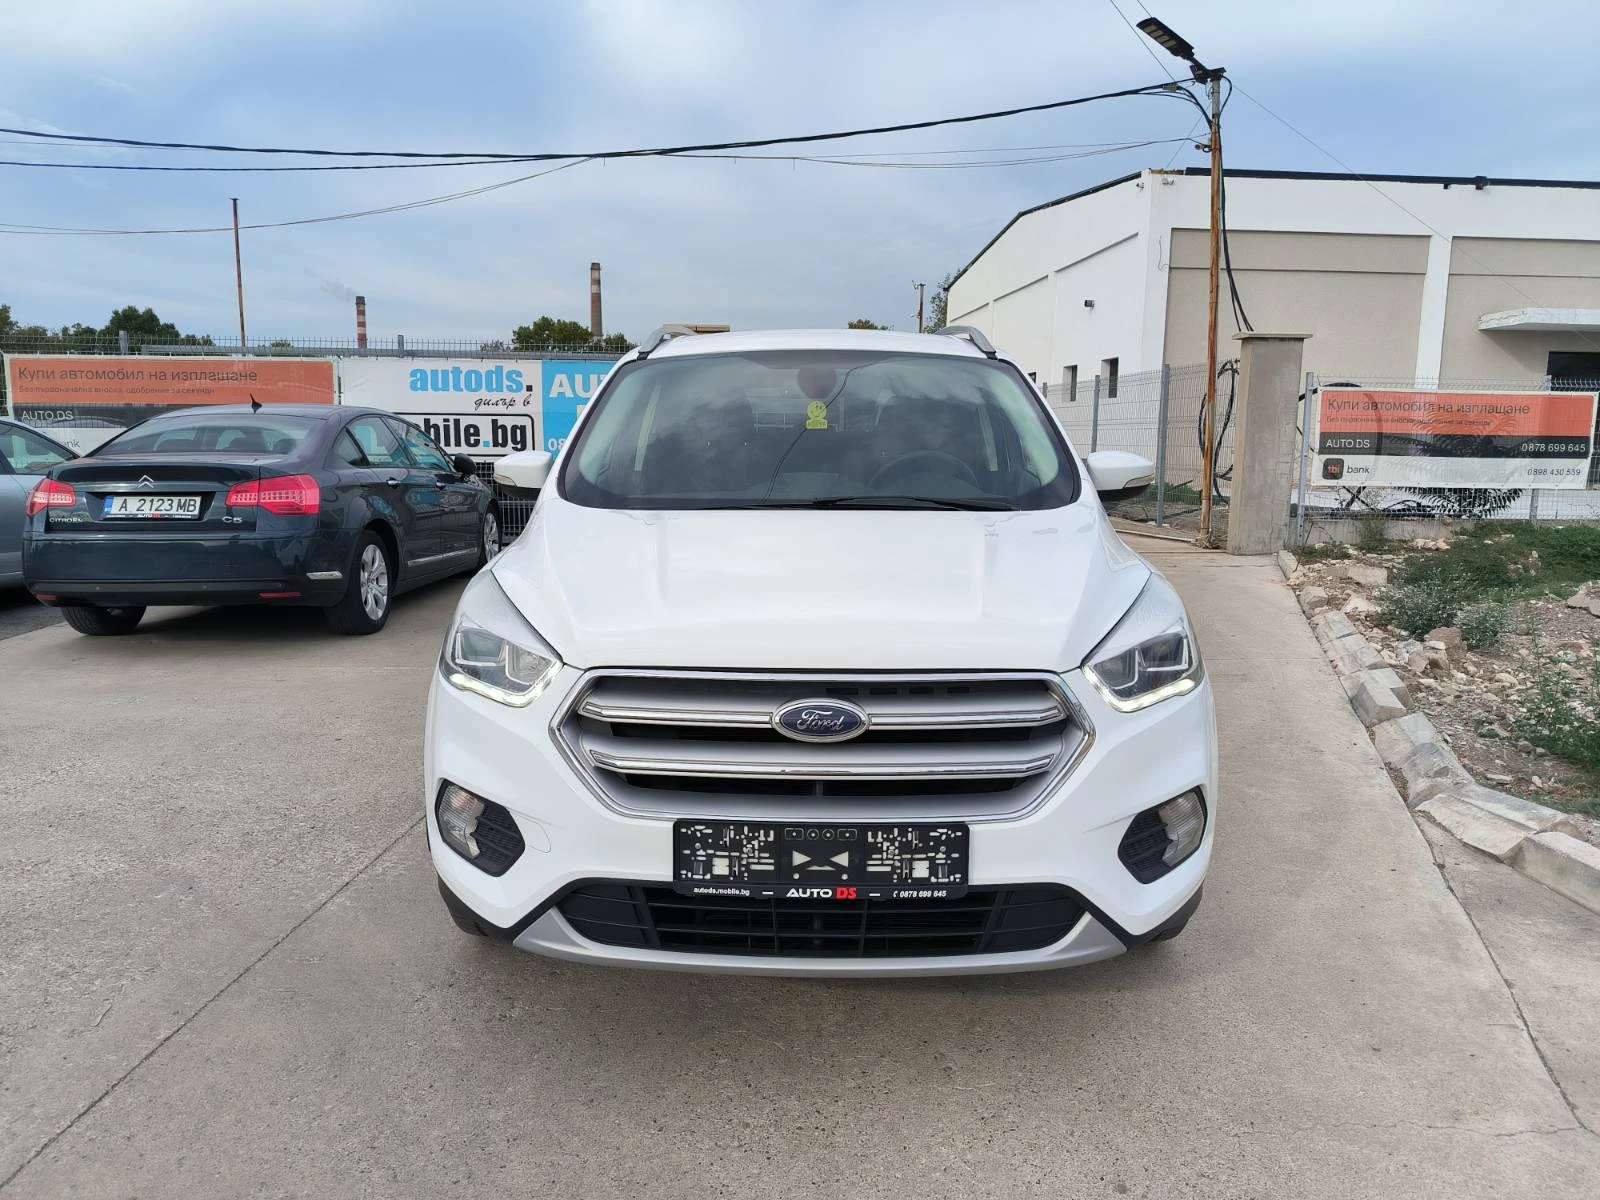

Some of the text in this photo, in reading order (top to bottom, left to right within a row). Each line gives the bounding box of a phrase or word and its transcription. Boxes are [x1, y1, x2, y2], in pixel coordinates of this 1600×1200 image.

[18, 367, 257, 383] Купи автомобил на изплащане
[409, 365, 533, 393] autods.
[549, 373, 607, 399] AU
[1328, 399, 1531, 415] Купи автомобил на изплащане
[417, 417, 528, 452] bile.bg
[547, 438, 567, 451] 08
[1325, 439, 1371, 449] AUTO DS
[1521, 443, 1587, 453] 0878 699 645
[1345, 465, 1370, 474] bank
[118, 498, 128, 512] A
[136, 498, 174, 512] 2123
[176, 498, 197, 513] MB
[222, 516, 243, 524] C5
[796, 708, 845, 731] Ford
[693, 887, 750, 897] autods.mobile.bg
[786, 888, 832, 898] AUTO
[836, 887, 857, 899] DS
[933, 890, 948, 898] 645
